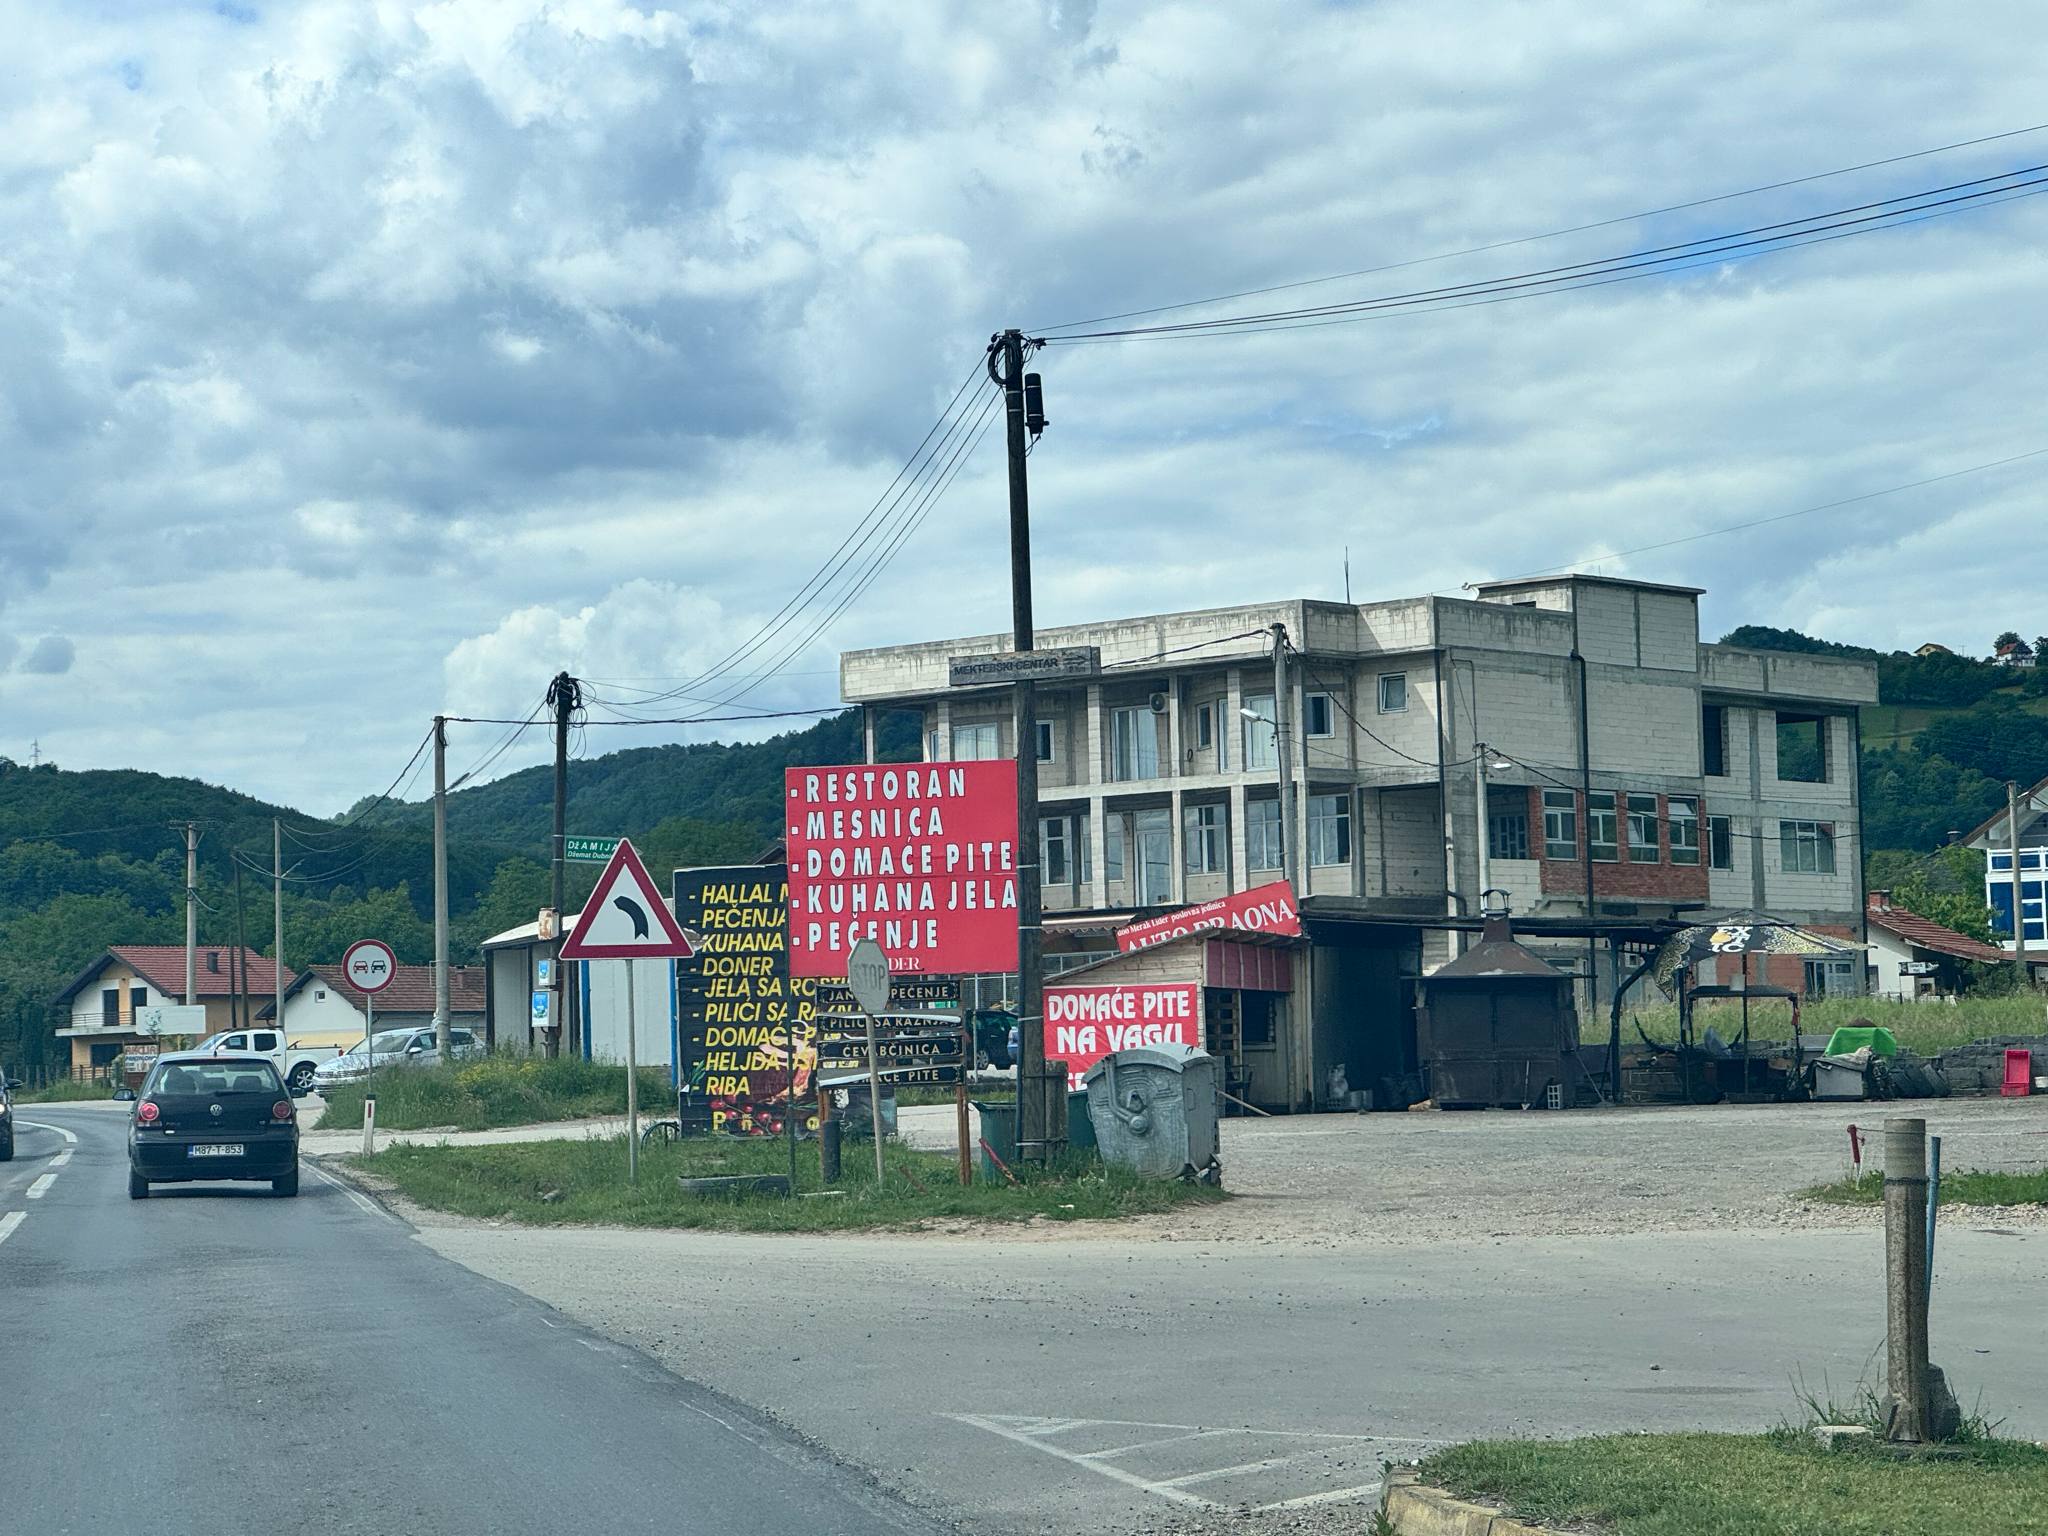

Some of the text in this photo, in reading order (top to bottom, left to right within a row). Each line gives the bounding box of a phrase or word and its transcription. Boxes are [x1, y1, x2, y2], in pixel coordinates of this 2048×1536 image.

[806, 768, 965, 802] RESTORAN
[806, 806, 944, 840] MESNICA
[807, 836, 1012, 877] DOMAĆE PITE
[701, 883, 773, 905] HALLAL
[807, 882, 935, 914] KUHANA
[947, 879, 1018, 910] JELA
[701, 932, 785, 953] KUHANA
[808, 913, 938, 951] PEČENJE
[702, 956, 774, 977] DONER
[888, 957, 920, 971] DER
[854, 962, 887, 990] STOP
[704, 977, 751, 998] JELA
[756, 977, 783, 997] SA
[890, 984, 949, 999] PEČENJE
[704, 997, 761, 1023] PILIĆI
[1048, 987, 1190, 1022] DOMAĆE PITE
[842, 1041, 941, 1057] ĆEVBČINICA
[1057, 1022, 1183, 1055] NA VAGU
[705, 1051, 780, 1072] HELJDA
[908, 1069, 939, 1081] PITE
[705, 1076, 751, 1096] RIBA
[194, 1145, 243, 1155] M87-T-853
